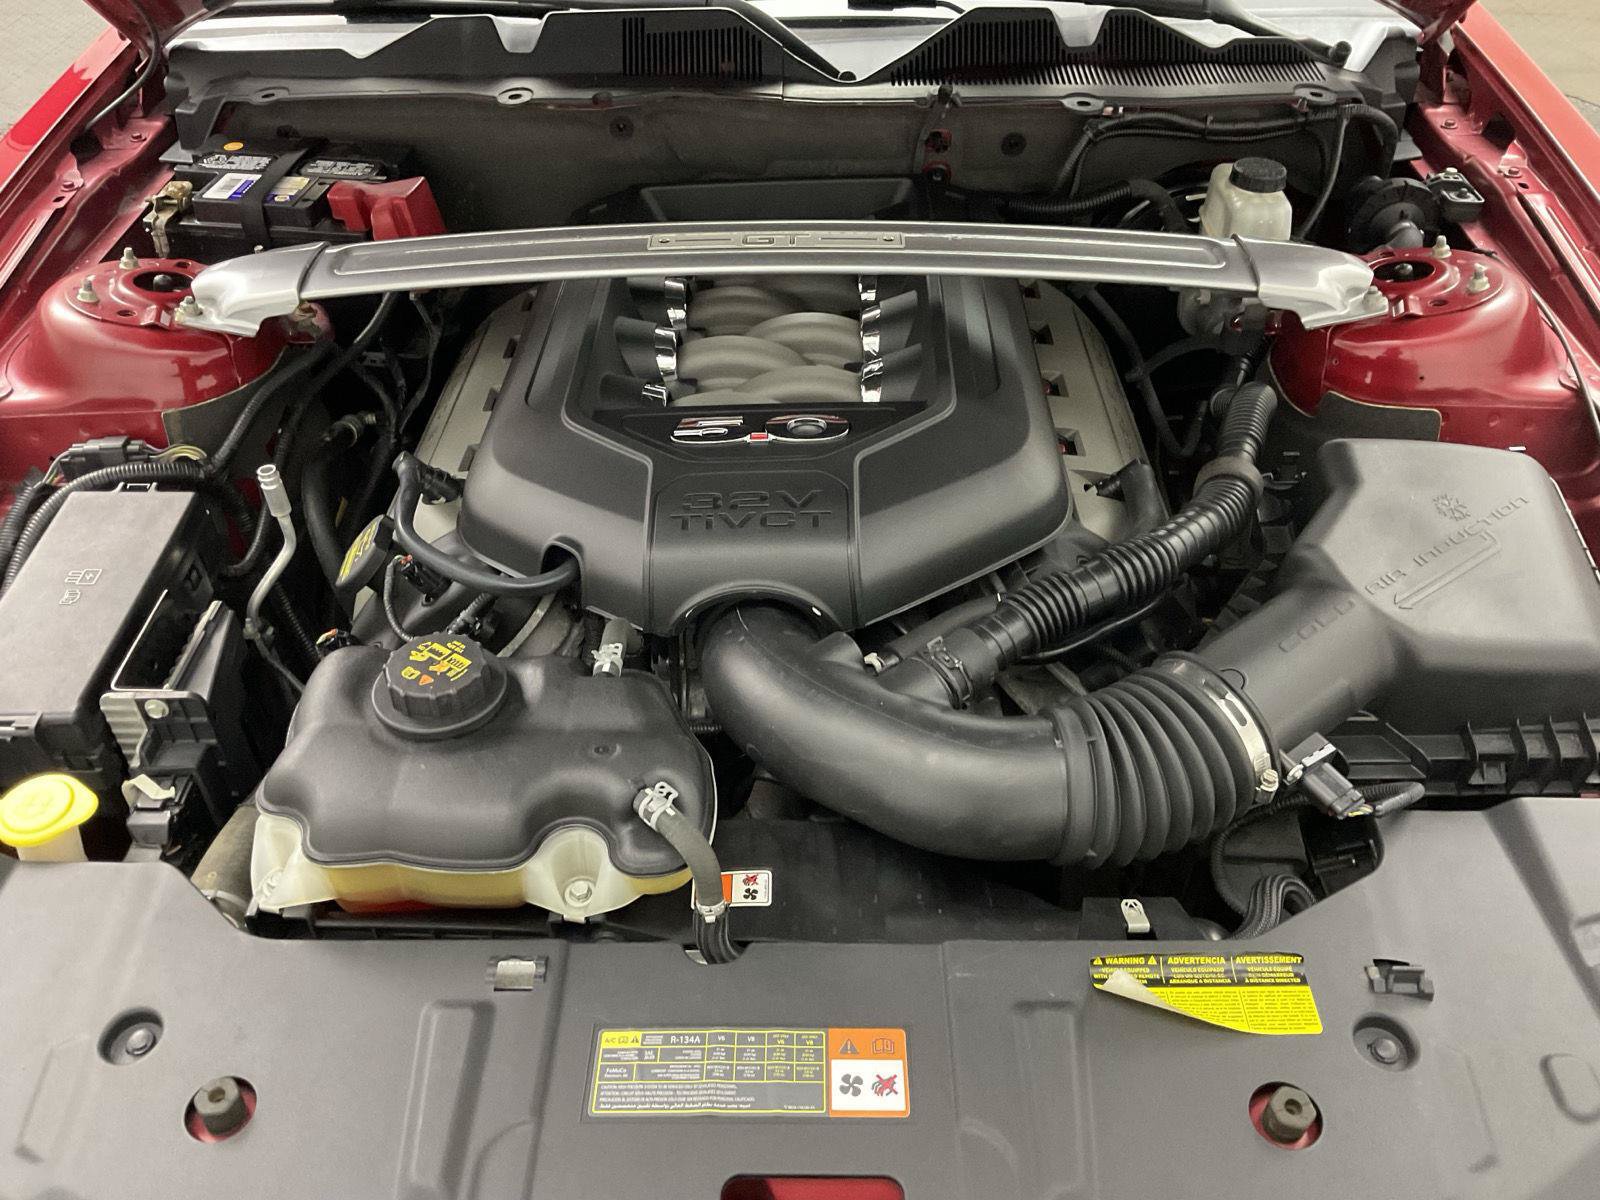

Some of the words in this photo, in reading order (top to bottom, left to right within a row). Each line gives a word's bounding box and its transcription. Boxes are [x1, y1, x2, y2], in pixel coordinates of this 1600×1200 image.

[742, 232, 812, 248] GT
[670, 413, 851, 445] 5.0
[682, 489, 824, 510] 32V
[1277, 597, 1357, 654] COLD
[1363, 568, 1408, 596] AIR
[1105, 957, 1145, 965] WARNING
[1167, 956, 1226, 965] ADVERTENCIA
[1235, 956, 1303, 964] AVERTISSEMENT
[670, 1035, 700, 1044] R-134A
